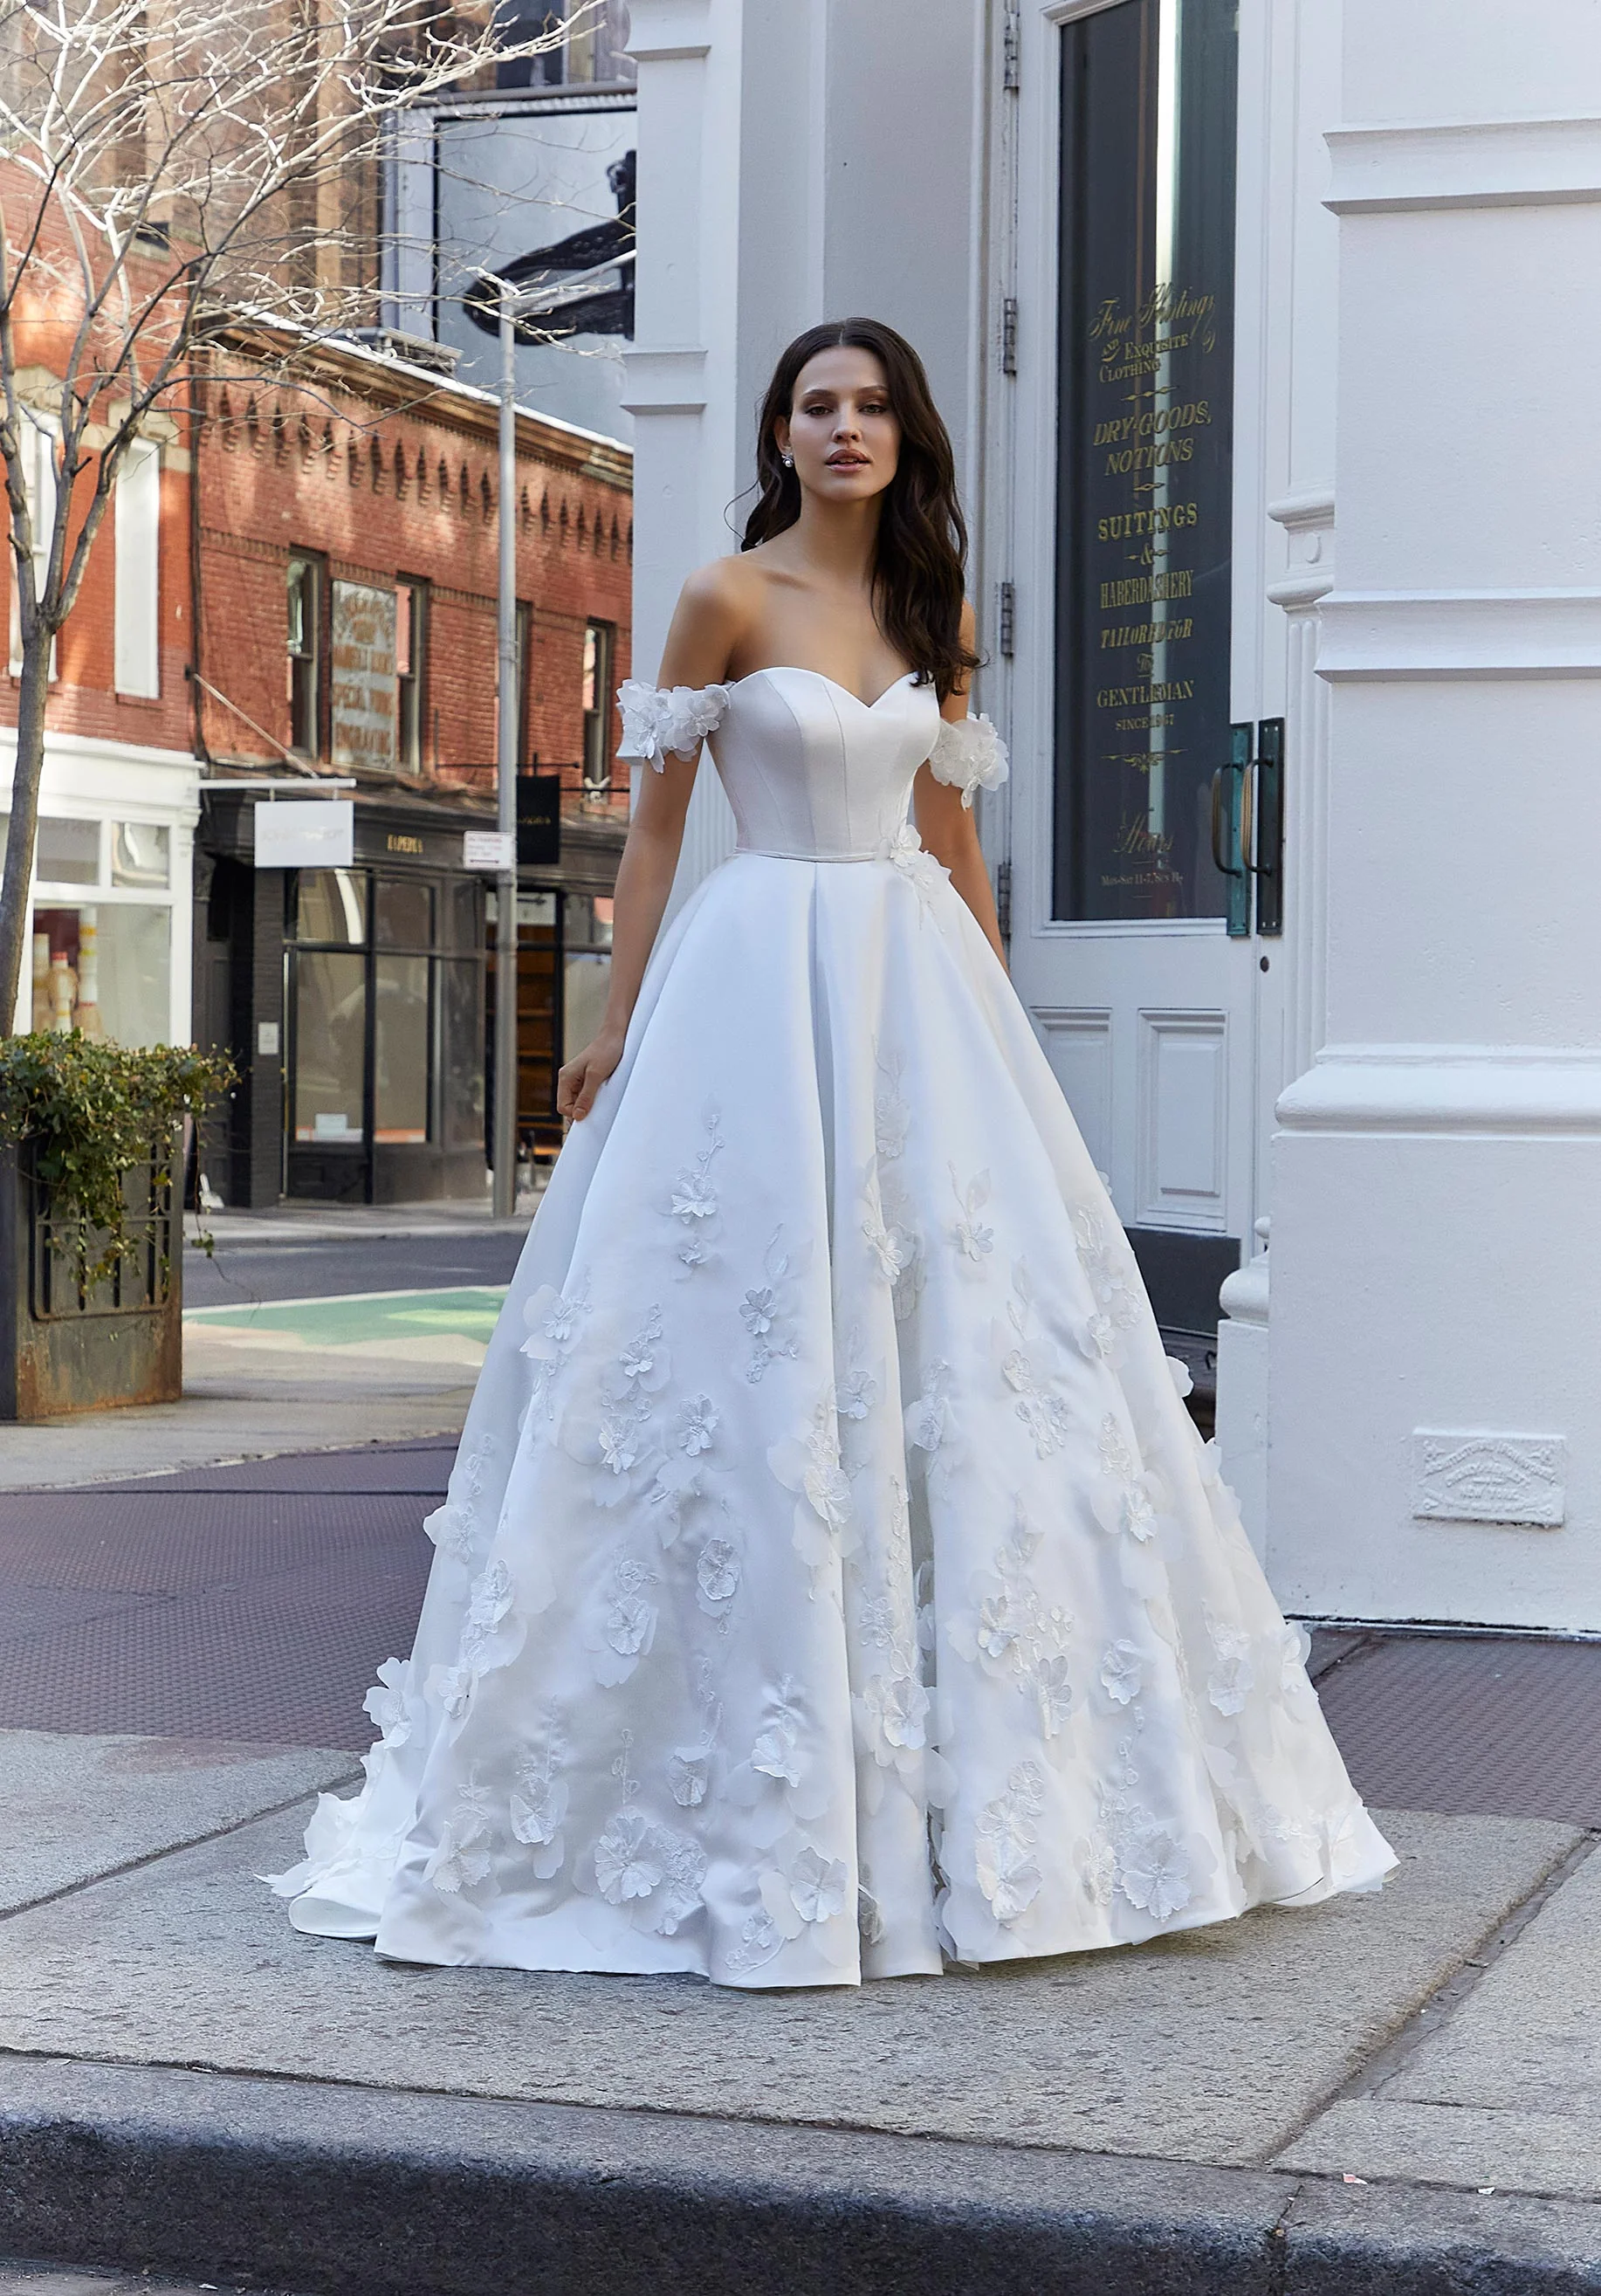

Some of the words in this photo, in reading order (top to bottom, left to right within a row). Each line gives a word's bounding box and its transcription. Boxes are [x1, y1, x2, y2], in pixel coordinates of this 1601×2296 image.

[1090, 298, 1130, 340] Fine
[1104, 437, 1194, 477] NOTIONS
[1098, 503, 1198, 541] SUITINGS
[1101, 570, 1194, 609] HABERDASHERY
[1101, 622, 1165, 649] TAILORED
[1096, 680, 1194, 708] GENTLEMAN
[1116, 716, 1149, 732] SINCE
